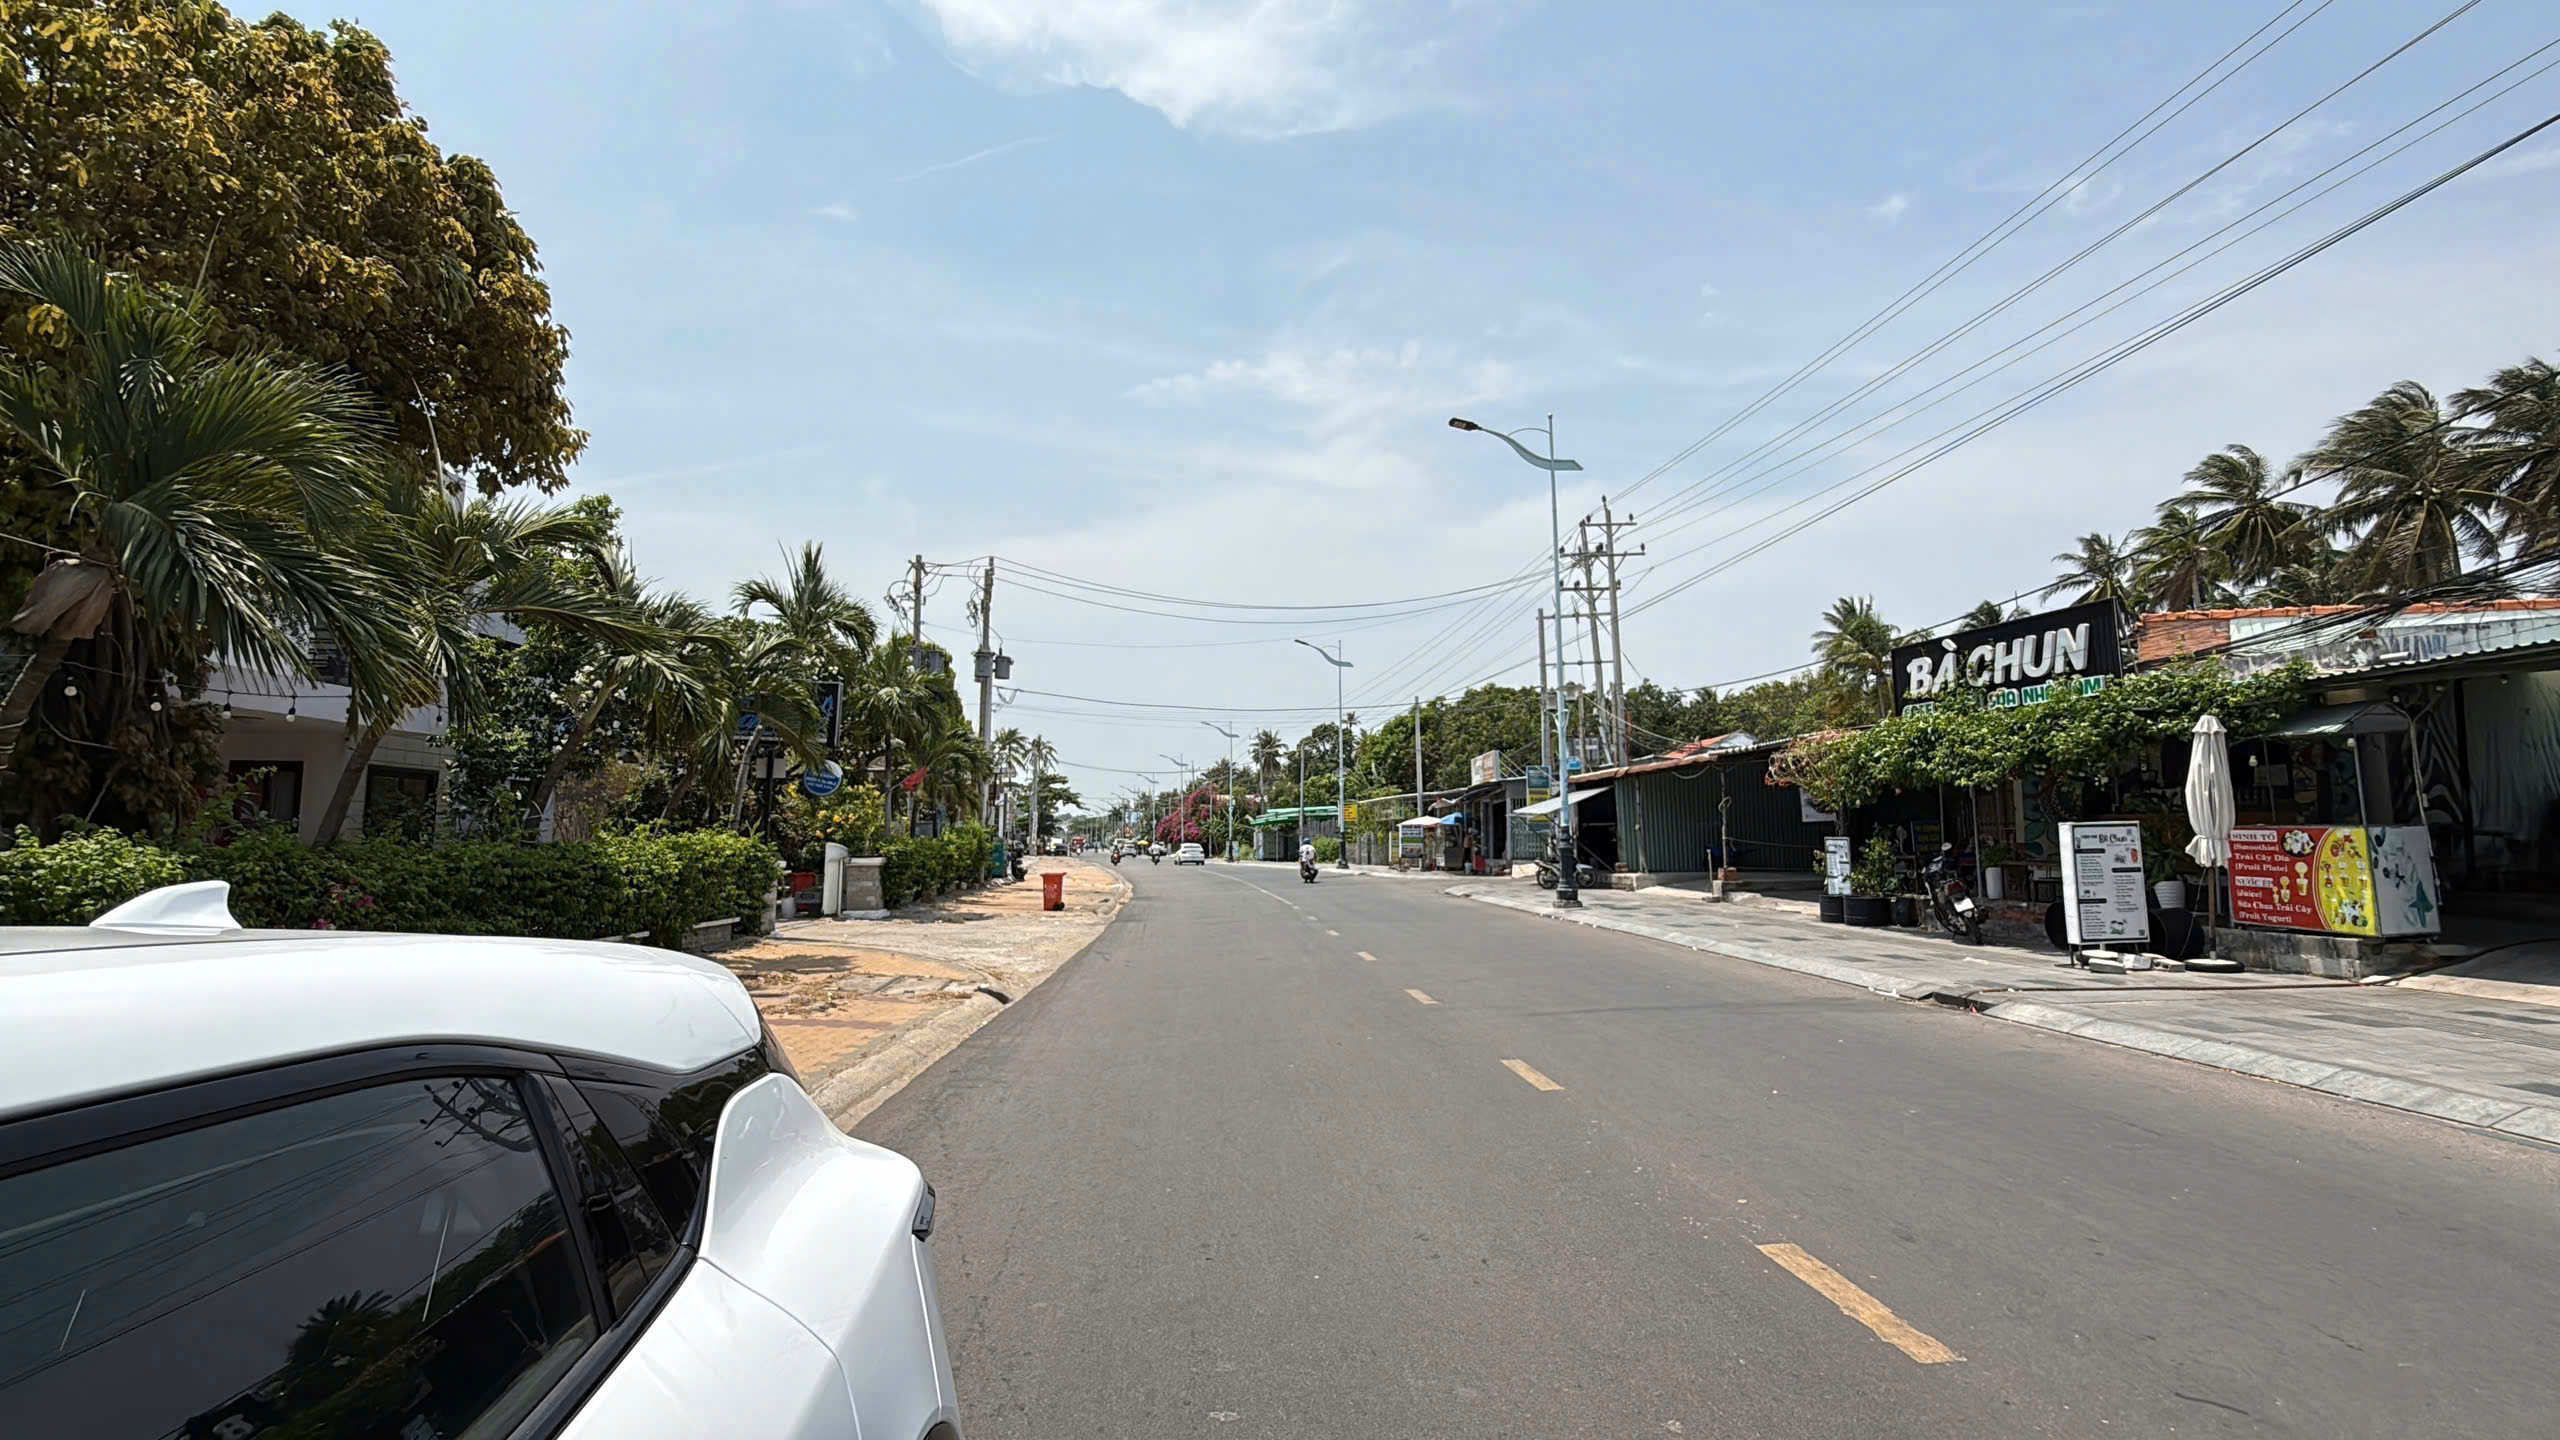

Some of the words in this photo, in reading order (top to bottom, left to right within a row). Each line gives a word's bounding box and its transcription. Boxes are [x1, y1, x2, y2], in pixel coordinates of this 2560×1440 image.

[1906, 638, 1958, 695] BÀ
[1966, 622, 2091, 687] CHUN
[2231, 833, 2257, 841] SINH
